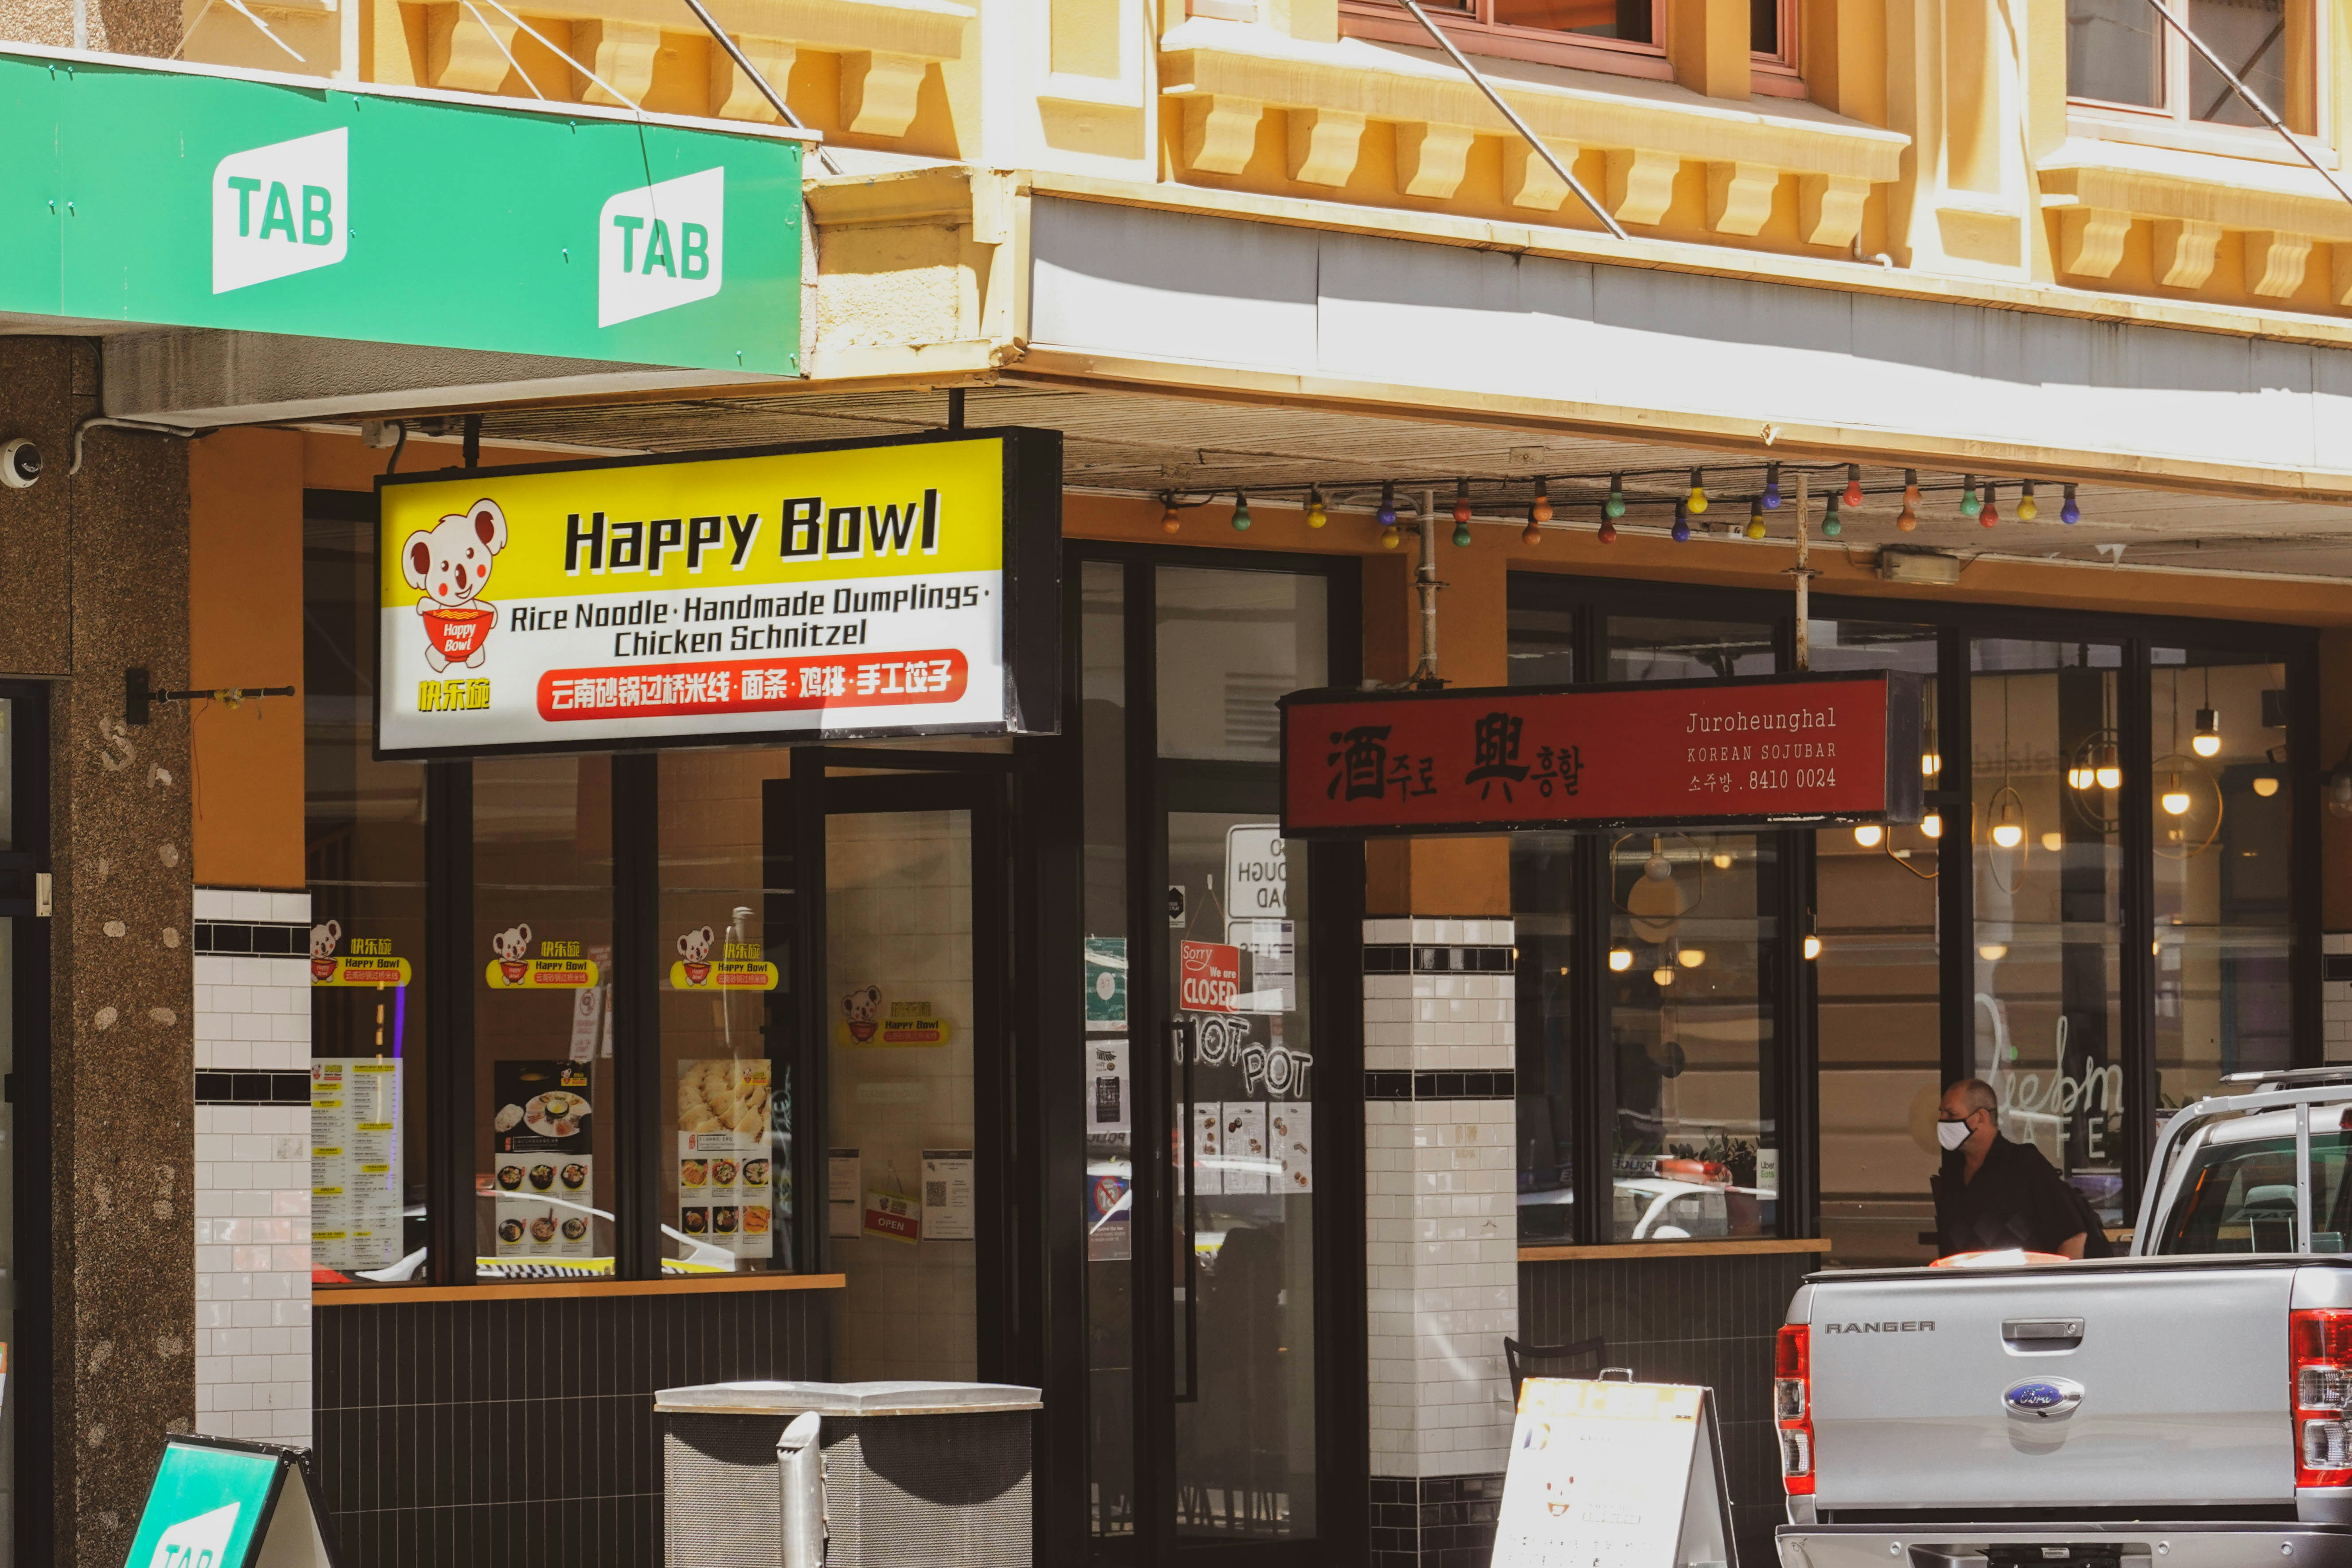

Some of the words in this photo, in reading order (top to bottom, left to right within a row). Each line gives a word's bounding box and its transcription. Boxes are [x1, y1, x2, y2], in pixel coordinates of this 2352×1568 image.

[228, 176, 333, 246] TAB
[614, 215, 709, 280] TAB
[564, 511, 759, 572] Happy
[779, 488, 940, 559] Bowl
[510, 606, 568, 632] Rice
[685, 592, 824, 622] Handmade
[443, 623, 476, 639] Happy
[614, 626, 721, 658] Chicken
[731, 619, 867, 652] Schnitzel
[444, 637, 471, 652] Bowl
[418, 677, 490, 712] 快乐碗
[1687, 707, 1836, 733] Juroheunghal
[1687, 746, 1752, 762] KOREAN
[1761, 743, 1836, 760] SOJUBAR
[1749, 770, 1788, 790] 8410
[1796, 768, 1836, 788] 0024
[345, 958, 374, 968] Happy
[377, 958, 399, 968] Bowl
[536, 961, 564, 970] Happy
[566, 961, 587, 970] Bowl
[718, 962, 744, 972] Happy
[747, 963, 767, 972] Bowl
[1183, 945, 1213, 971] Sorry
[1210, 966, 1221, 978] We
[1183, 978, 1237, 1007] CLOSED
[885, 1021, 913, 1029] Happy
[916, 1021, 939, 1029] Bowl
[1241, 1042, 1313, 1098] POT
[2013, 1117, 2106, 1158] AFE
[878, 1218, 905, 1231] OPEN
[1825, 1321, 1936, 1334] RANGER
[2020, 1387, 2054, 1404] Ford
